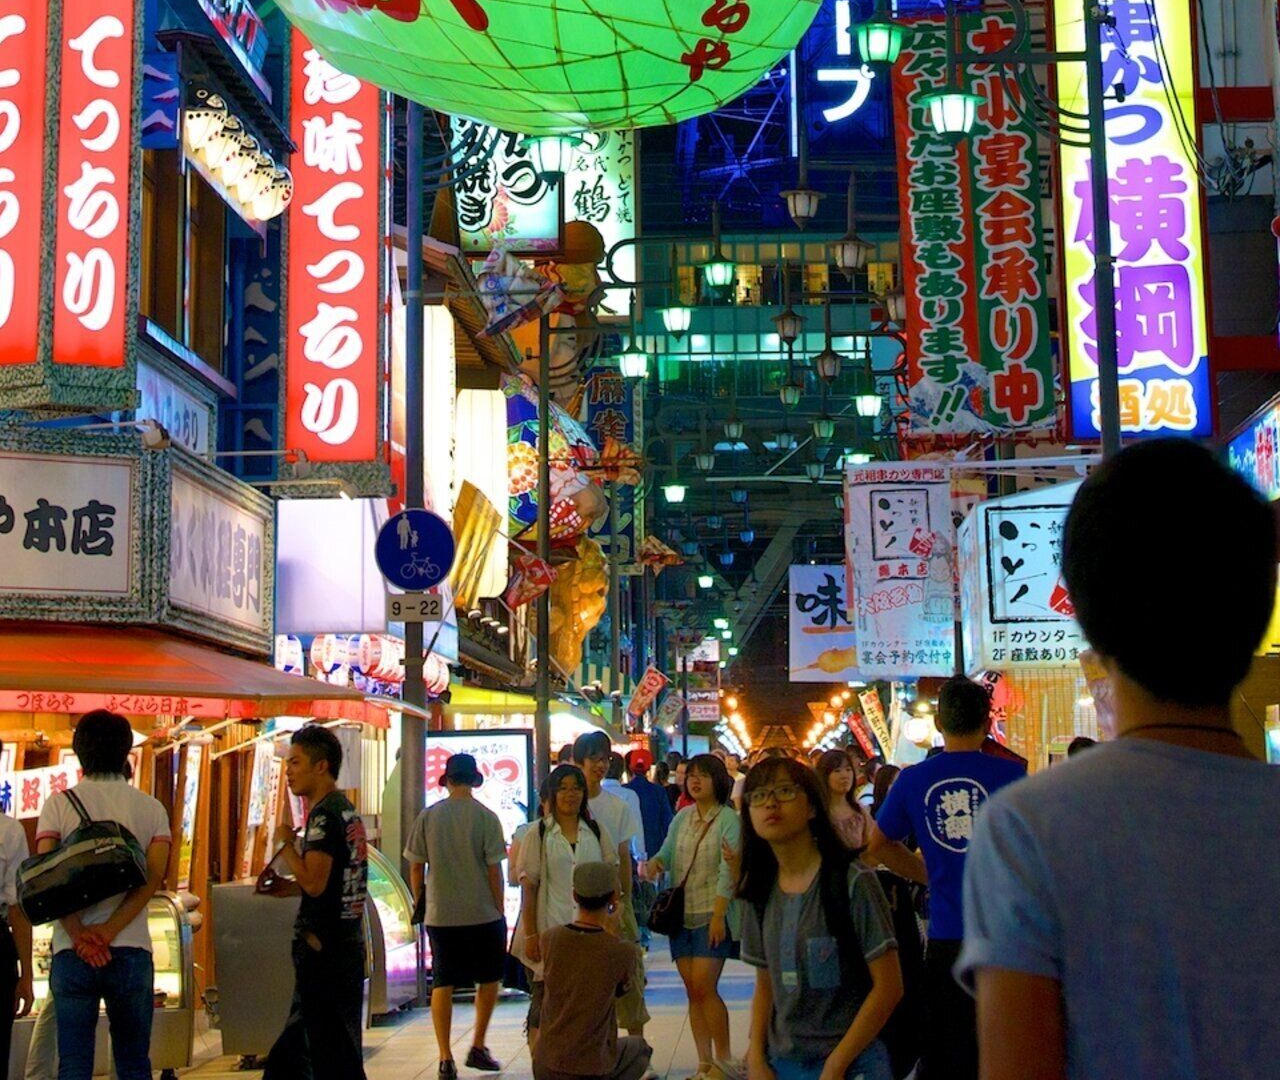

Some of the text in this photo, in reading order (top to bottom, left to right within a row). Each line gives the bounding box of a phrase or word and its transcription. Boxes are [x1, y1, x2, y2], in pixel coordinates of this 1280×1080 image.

[62, 14, 125, 332] てっちり
[969, 18, 1041, 419] 大小宴会承り中
[1073, 156, 1196, 372] 横綱
[589, 371, 630, 444] 麻雀
[795, 572, 852, 629] 味
[861, 650, 952, 666] 宴会予約受付中
[992, 649, 1005, 661] 2F
[993, 631, 1005, 642] 1F
[425, 746, 519, 793] 串つ
